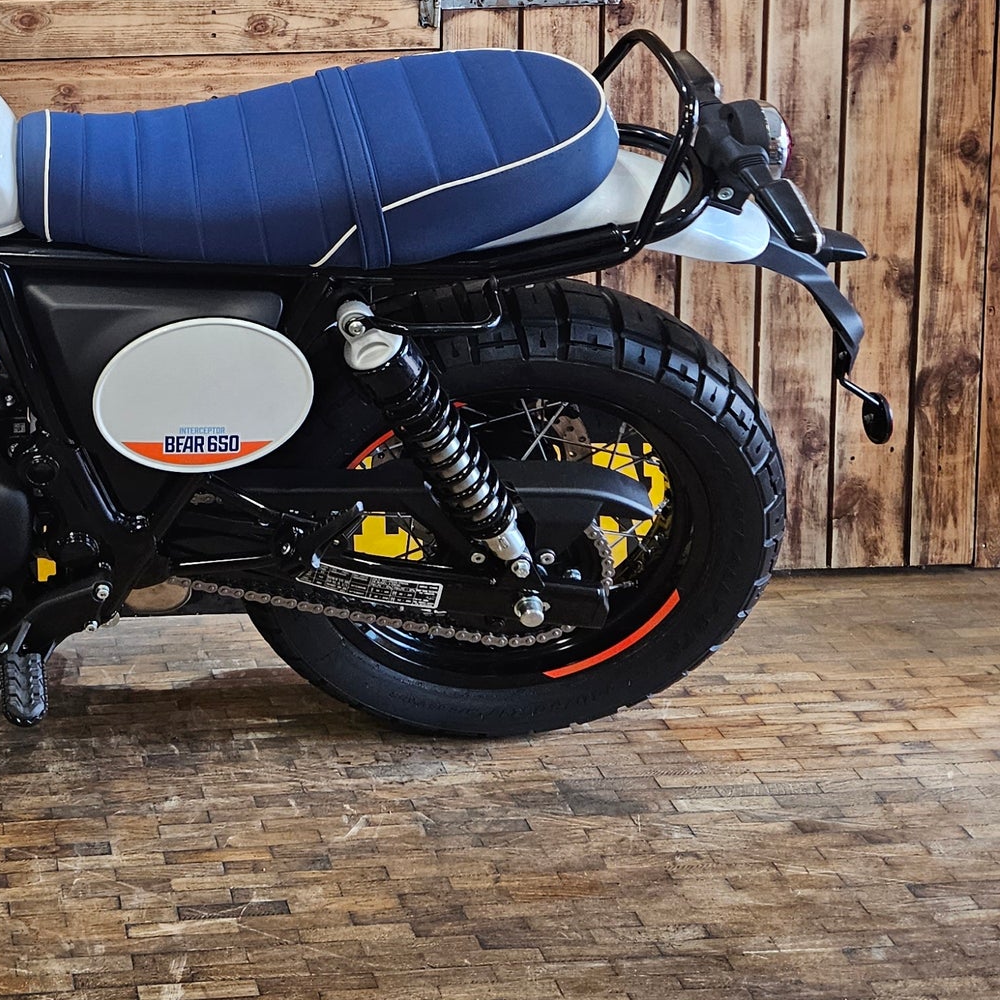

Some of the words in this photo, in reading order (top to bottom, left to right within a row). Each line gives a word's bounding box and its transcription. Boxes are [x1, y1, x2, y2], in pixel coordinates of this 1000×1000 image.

[179, 426, 225, 434] INTERCEPTOR
[164, 435, 205, 453] BEAR
[207, 435, 240, 452] 650
